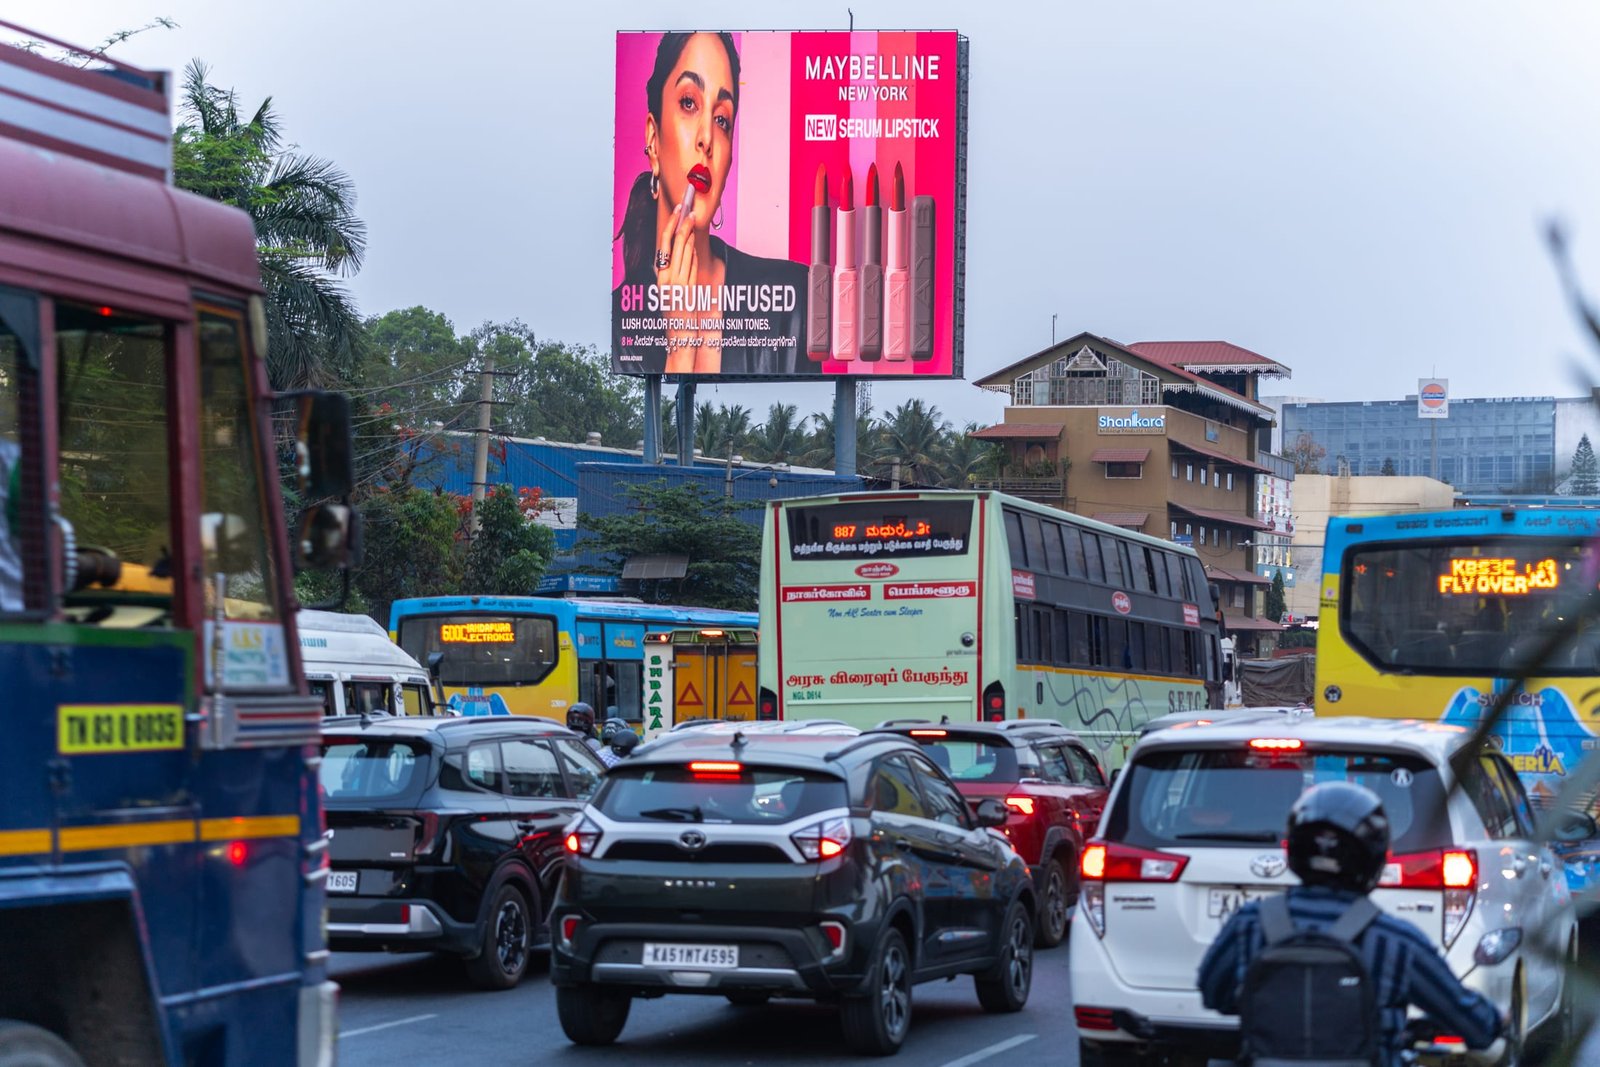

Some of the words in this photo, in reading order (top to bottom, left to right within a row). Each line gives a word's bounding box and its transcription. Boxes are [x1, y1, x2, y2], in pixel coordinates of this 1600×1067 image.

[805, 55, 940, 80] MAYBELLINE
[838, 86, 868, 101] NEW
[871, 86, 908, 101] YORK
[807, 119, 835, 138] NEW
[838, 118, 882, 138] SERUM
[885, 118, 940, 138] LIPSTICK
[621, 284, 644, 312] 8H
[647, 284, 796, 312] SERUM-INFUSED
[621, 318, 641, 330] LUSH
[642, 318, 668, 330] COLOR
[669, 318, 684, 330] FOR
[685, 318, 699, 330] ALL
[700, 318, 724, 331] INDIAN
[726, 318, 743, 331] SKIN
[744, 318, 771, 331] TONES.
[621, 336, 626, 346] 8
[1099, 409, 1165, 428] Shankara
[834, 525, 857, 538] 887
[786, 586, 867, 601] நாகர்கோவில்
[887, 584, 970, 597] பெங்களூரு
[827, 607, 842, 618] Non
[860, 607, 882, 617] Seater
[899, 606, 924, 618] Sleeper
[298, 637, 328, 649] HWIN
[786, 673, 826, 689] அரசு
[829, 667, 899, 687] விரைவுப்
[902, 665, 969, 687] பேருந்து
[329, 875, 356, 888] 1605
